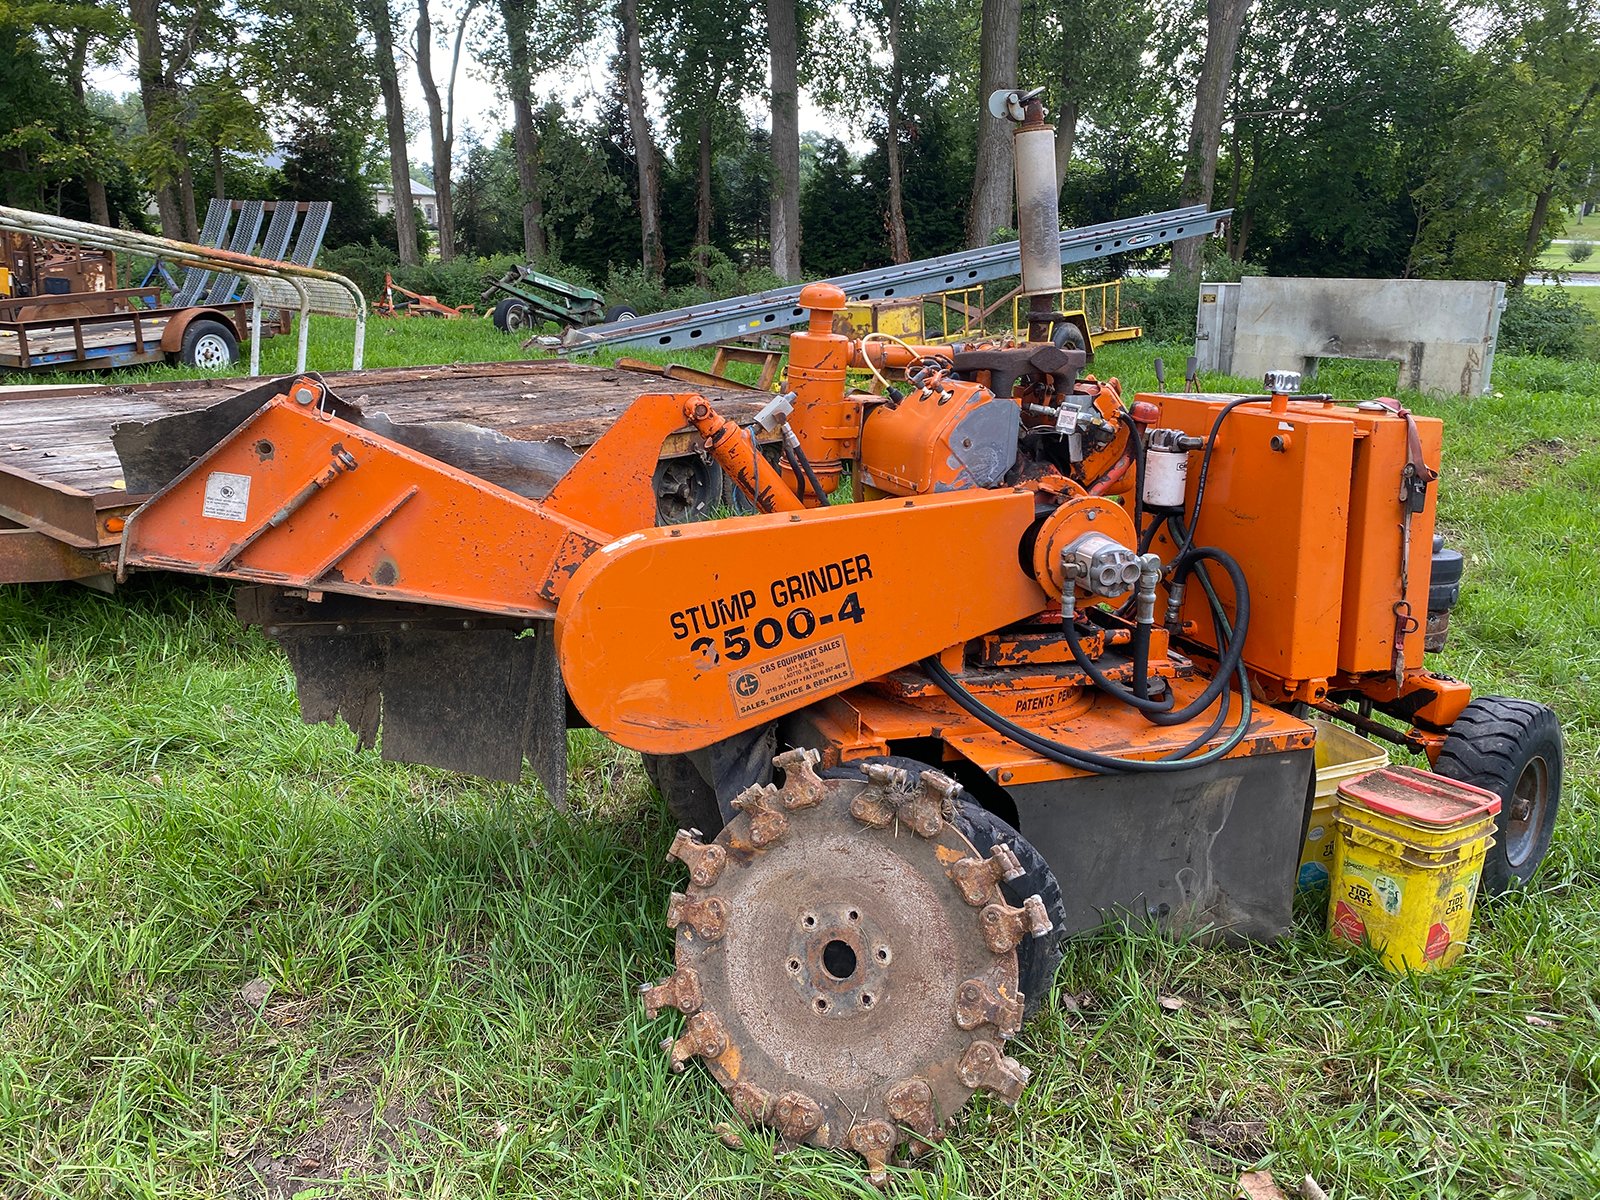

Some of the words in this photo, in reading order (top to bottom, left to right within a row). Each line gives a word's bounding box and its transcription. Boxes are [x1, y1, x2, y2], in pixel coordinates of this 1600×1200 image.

[670, 589, 757, 640] STUMP
[770, 553, 874, 608] GRINDER
[690, 591, 866, 671] 3500-4
[760, 664, 776, 675] C&S
[777, 648, 818, 669] EQUIPMENT
[819, 640, 841, 654] SALES
[803, 674, 813, 682] FAX
[740, 699, 769, 714] SALES,
[769, 686, 804, 702] SERVICE
[813, 670, 849, 688] RENTALS
[1015, 693, 1055, 712] PATENTS
[1348, 892, 1373, 907] CATS
[1349, 885, 1372, 899] TIDY
[1448, 895, 1465, 906] TIDY
[1445, 903, 1463, 915] CATS
